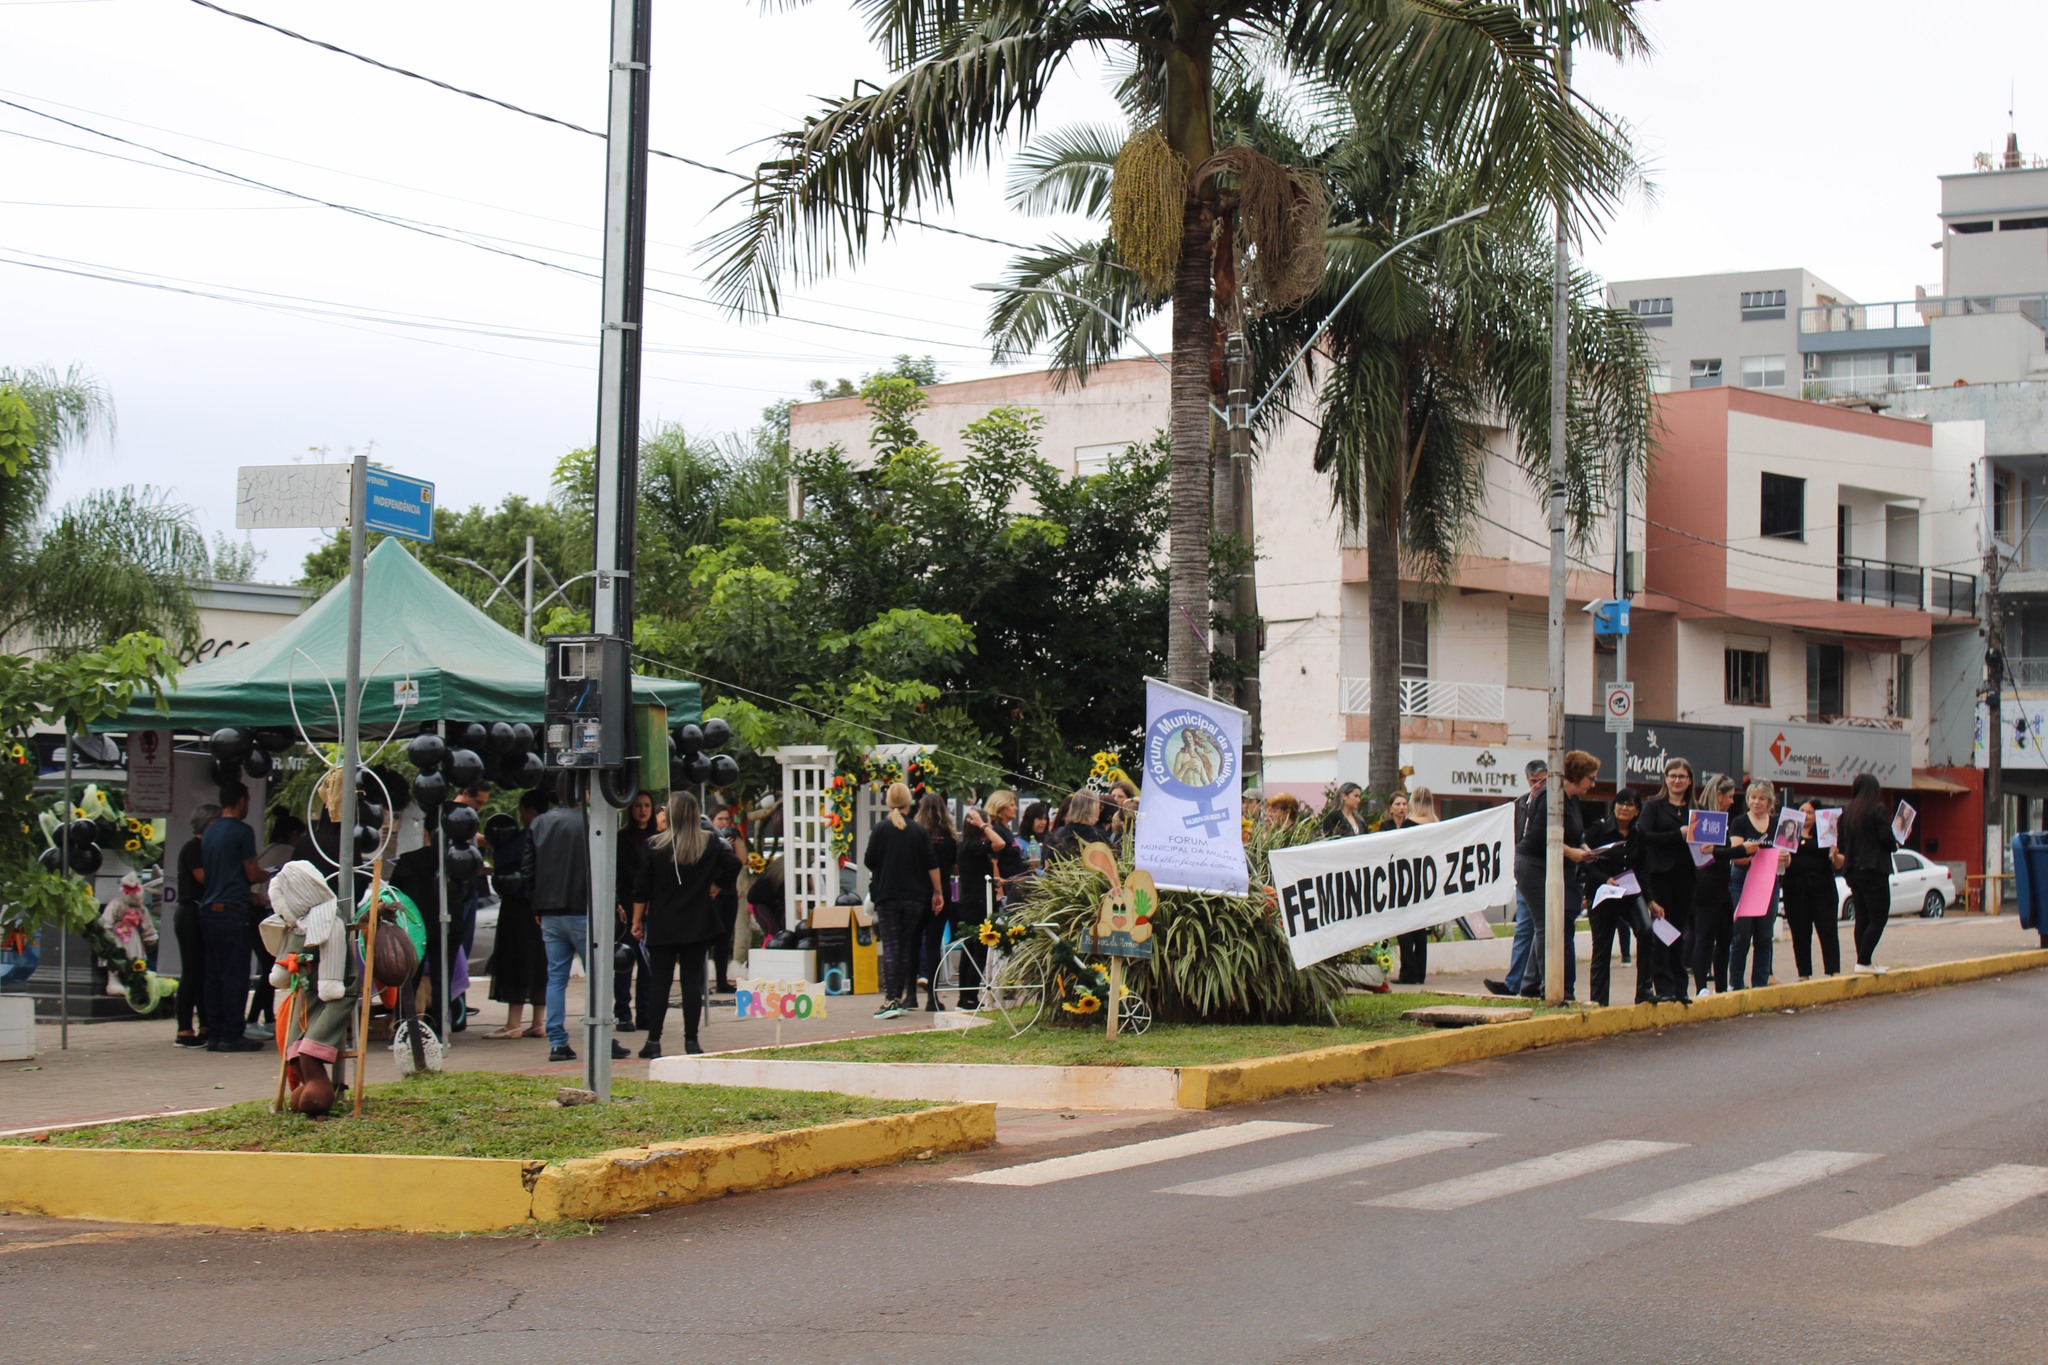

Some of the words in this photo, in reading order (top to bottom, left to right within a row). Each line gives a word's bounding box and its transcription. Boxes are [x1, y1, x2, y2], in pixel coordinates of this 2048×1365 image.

[366, 475, 389, 487] VENIDA
[373, 494, 421, 516] INDEPENDÊNCIA
[1157, 712, 1219, 735] Municipal
[1217, 735, 1229, 750] da
[1150, 735, 1170, 785] Fórum
[1215, 752, 1234, 788] Mulher
[1452, 771, 1482, 785] DIVINA
[1485, 772, 1518, 787] FEMME
[1168, 836, 1209, 846] FORUM
[1140, 844, 1189, 854] MUNICIPAL
[1191, 847, 1204, 855] DA
[1206, 850, 1238, 862] MULHER
[1281, 854, 1437, 937] FEMINICÍDIO
[1443, 841, 1502, 896] ZERO
[735, 990, 828, 1019] PASCOA
